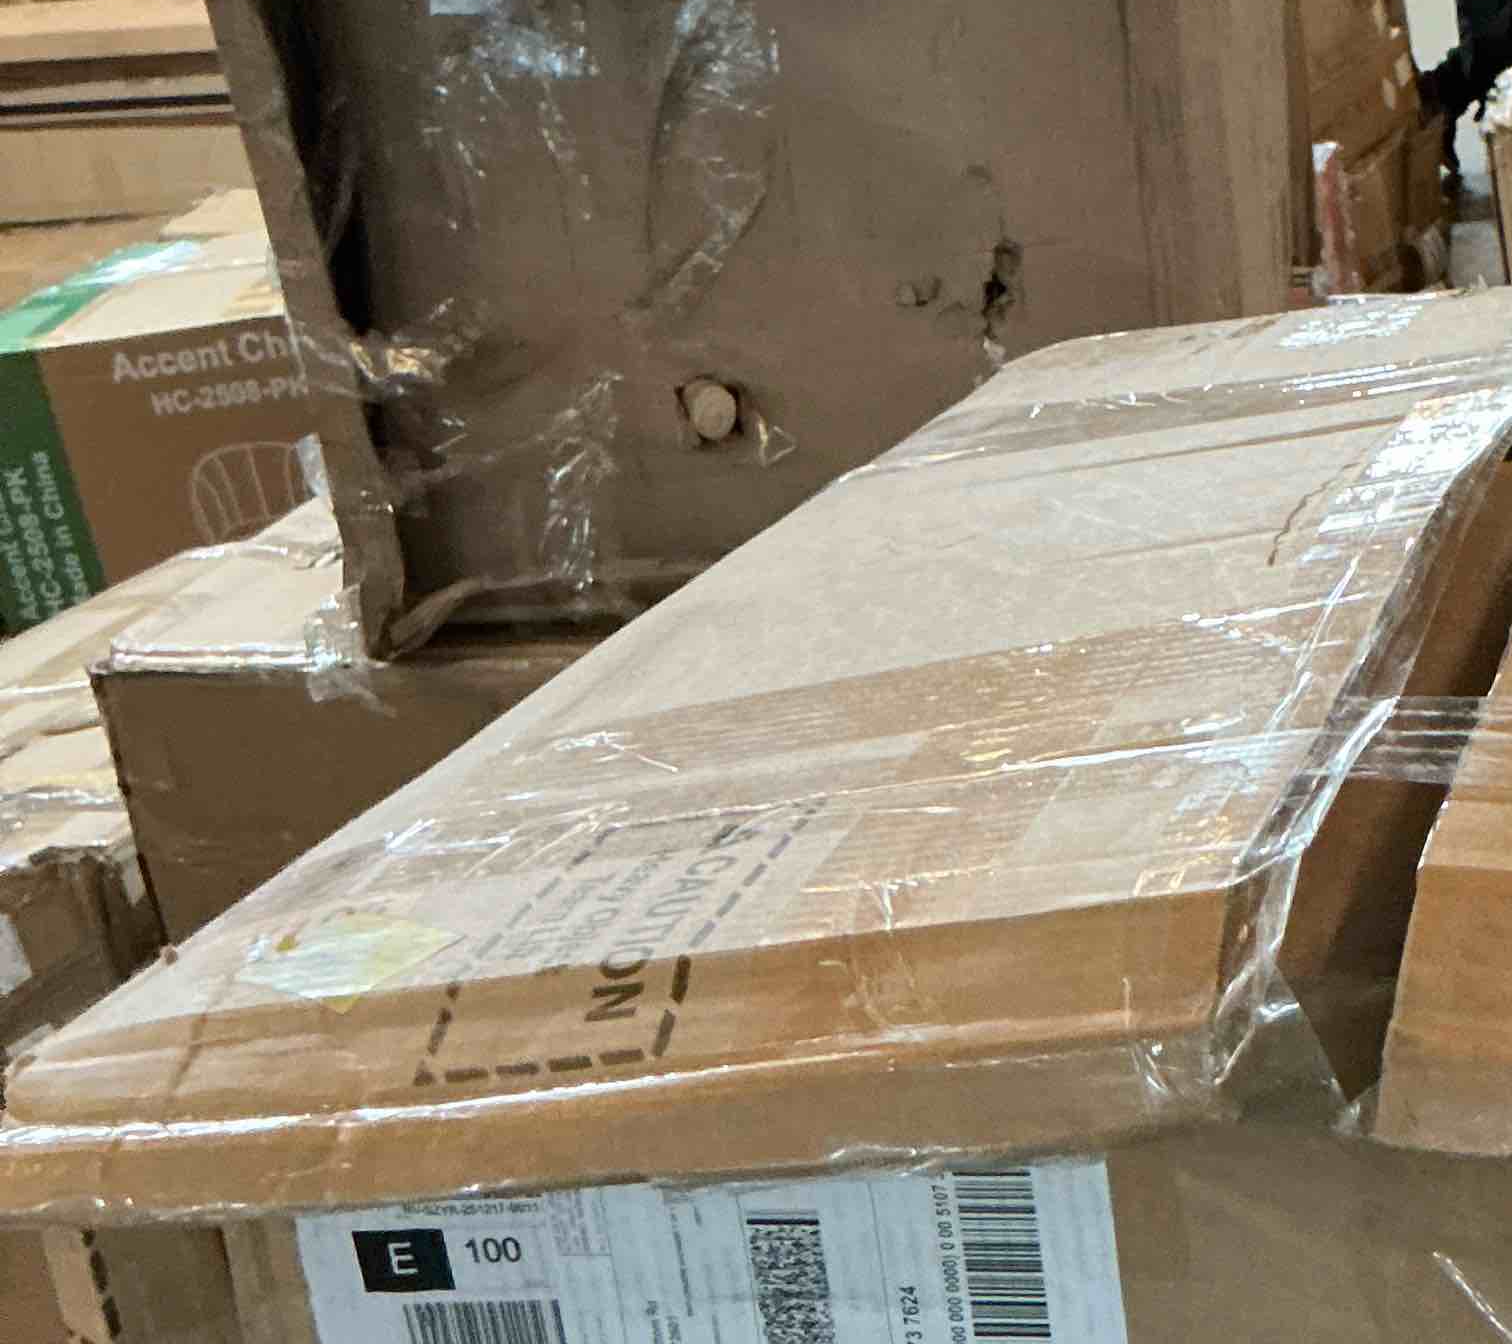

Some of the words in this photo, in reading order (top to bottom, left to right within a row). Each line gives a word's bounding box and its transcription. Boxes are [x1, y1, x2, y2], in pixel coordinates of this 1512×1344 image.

[111, 340, 233, 384] Accent
[32, 451, 65, 521] China
[64, 554, 90, 607] ade
[583, 856, 740, 1023] CAUTION
[936, 1221, 954, 1238] 00
[386, 1241, 419, 1275] E
[464, 1235, 522, 1264] 100
[900, 1285, 920, 1328] 7624
[945, 1296, 964, 1323] 000
